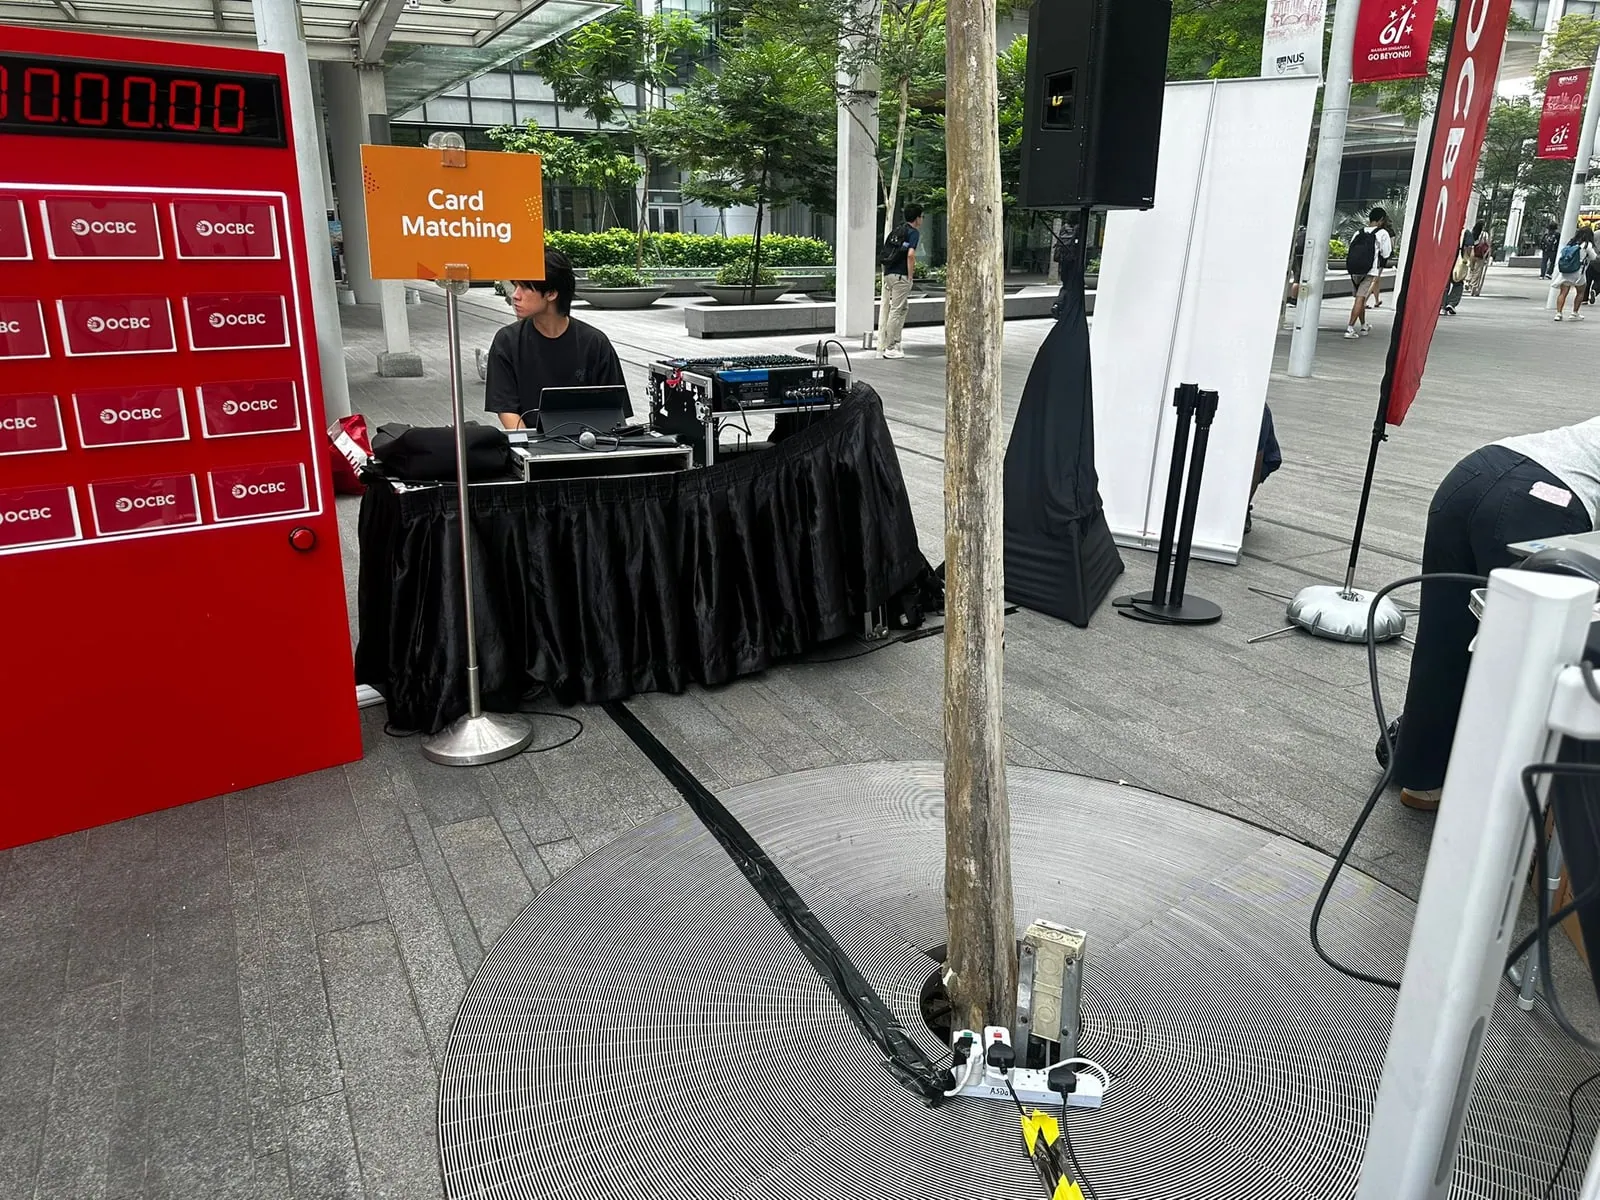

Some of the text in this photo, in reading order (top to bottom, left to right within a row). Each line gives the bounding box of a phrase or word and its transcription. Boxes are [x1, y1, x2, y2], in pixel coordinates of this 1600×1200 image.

[1379, 7, 1412, 45] 61
[1286, 52, 1305, 64] NUS
[1380, 51, 1411, 59] BEYOND!
[0, 65, 245, 134] 0.00.00
[1433, 0, 1489, 245] OCBC
[427, 188, 484, 211] Card
[90, 221, 137, 234] OCBC
[213, 222, 255, 235] OCBC
[401, 215, 512, 243] Matching
[106, 317, 151, 330] OCBC
[226, 313, 266, 325] OCBC
[239, 399, 278, 412] OCBC
[118, 407, 162, 421] OCBC
[0, 416, 37, 430] CBC
[247, 481, 286, 495] OCBC
[133, 494, 176, 509] OCBC
[4, 507, 52, 523] OCBC
